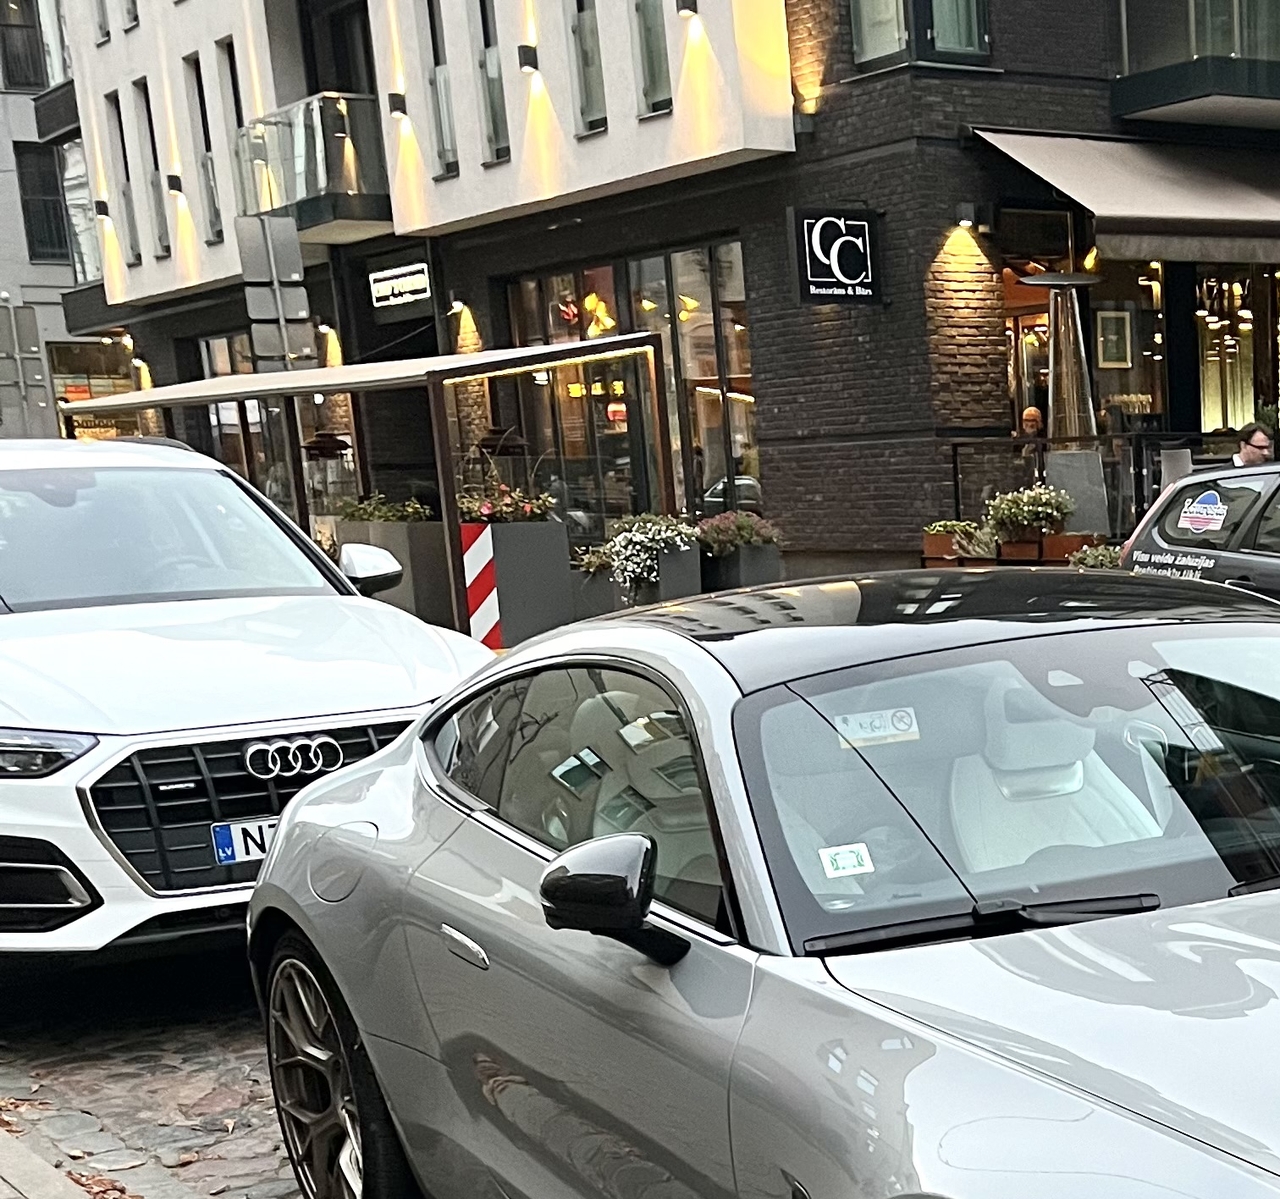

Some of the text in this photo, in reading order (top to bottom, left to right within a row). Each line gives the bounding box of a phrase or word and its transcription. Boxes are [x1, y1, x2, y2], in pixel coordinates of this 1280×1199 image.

[811, 216, 866, 284] CC
[1151, 552, 1175, 565] veidu
[218, 846, 233, 857] LV
